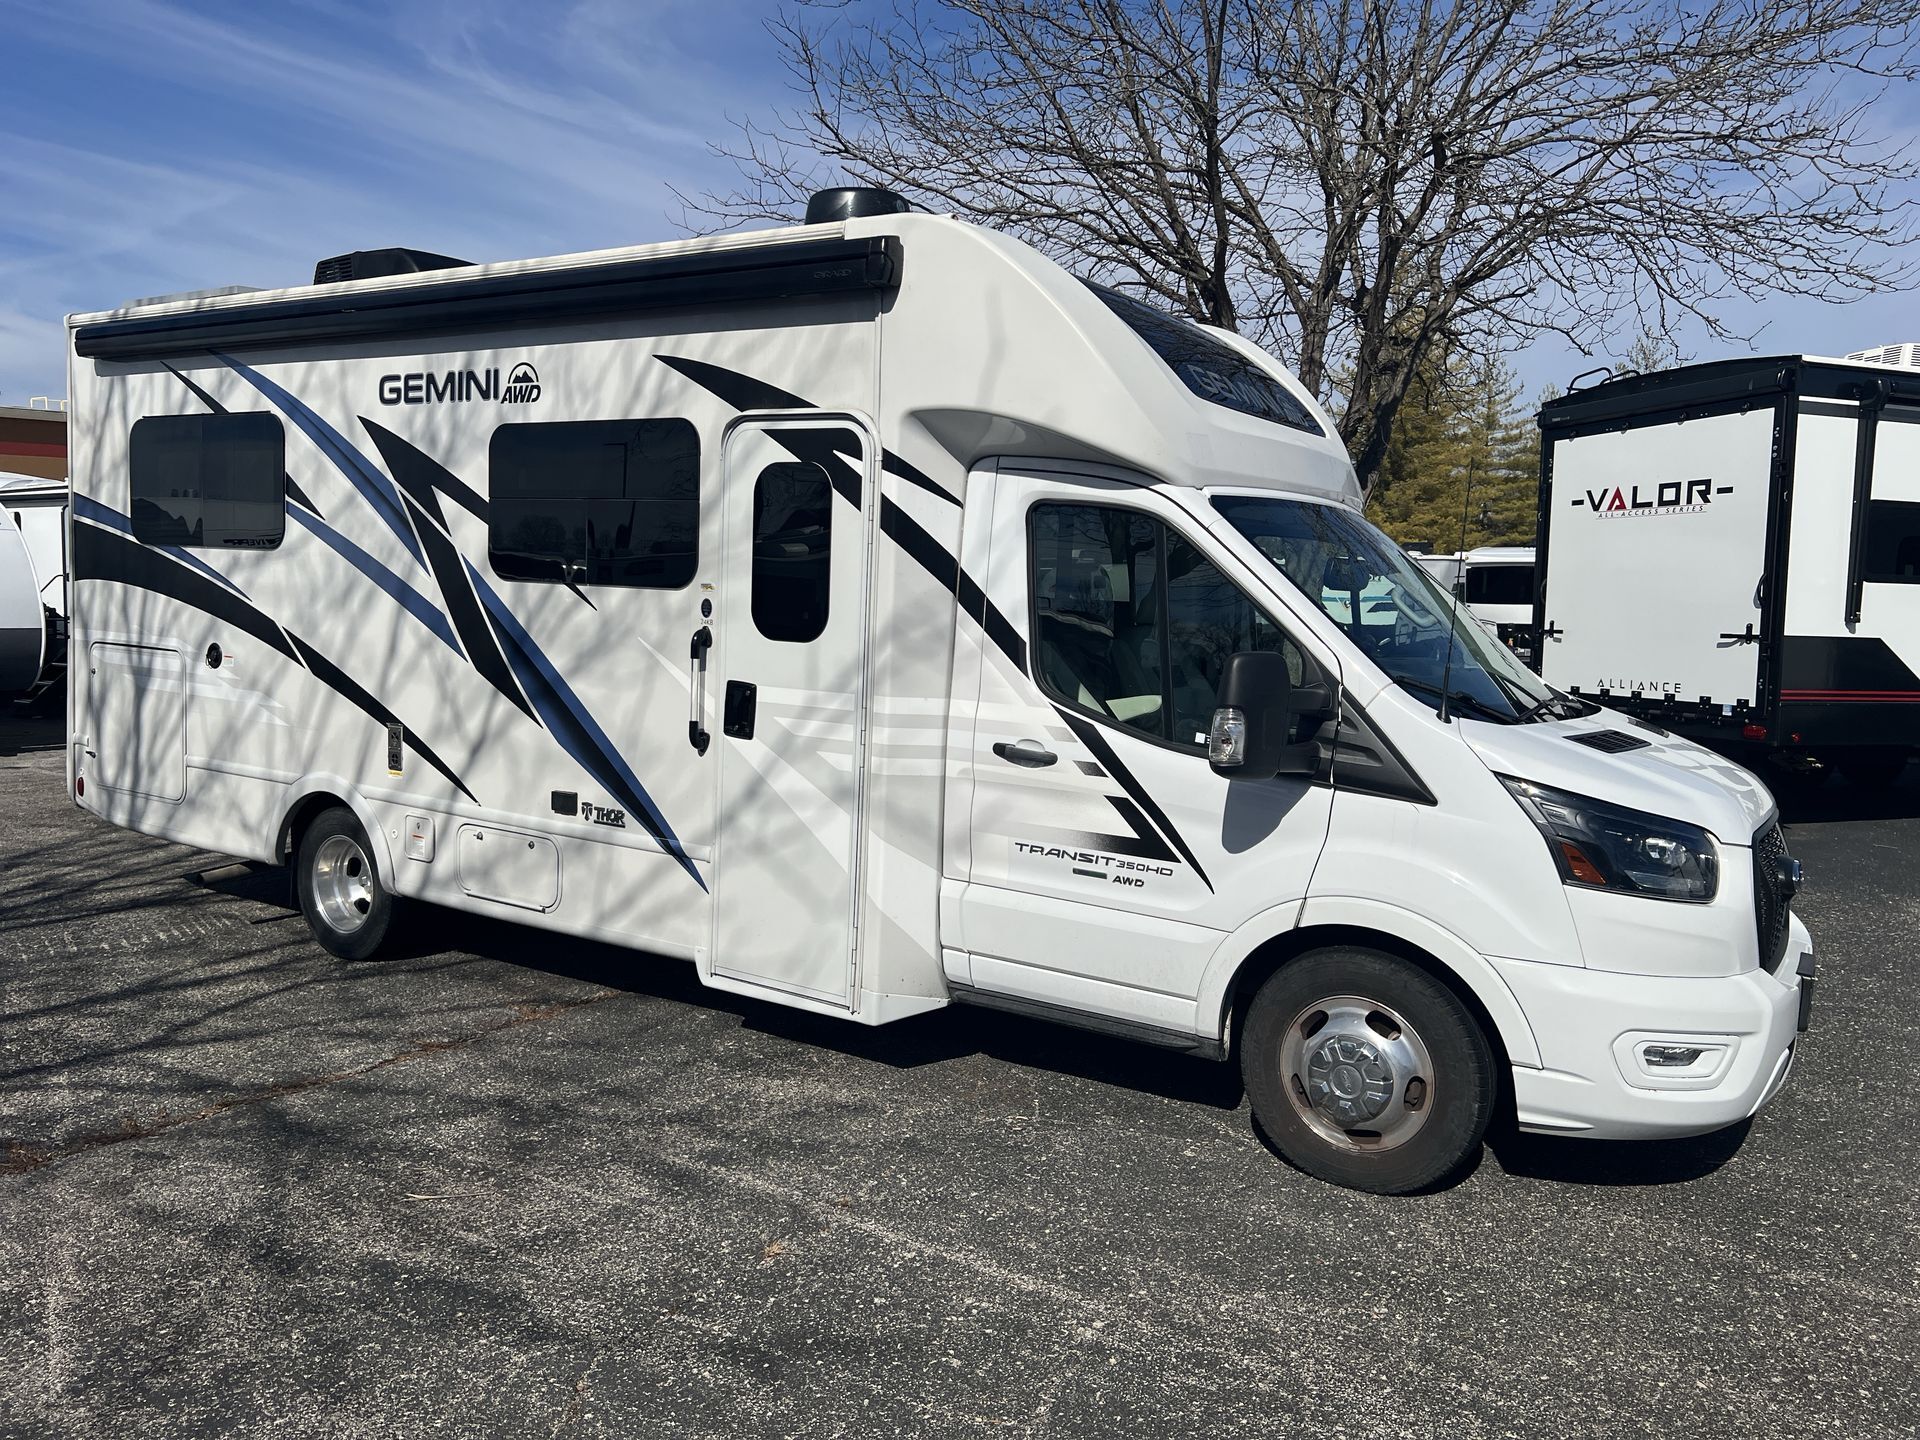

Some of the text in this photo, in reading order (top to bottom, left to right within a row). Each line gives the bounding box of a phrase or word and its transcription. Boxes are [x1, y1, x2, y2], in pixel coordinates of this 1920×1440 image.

[379, 367, 541, 406] GEMINI AWD
[1598, 505, 1704, 518] ALL-ACCESS SERIES
[1597, 678, 1682, 694] ALLIANCE
[594, 806, 626, 825] THOR
[1112, 875, 1145, 888] AWD
